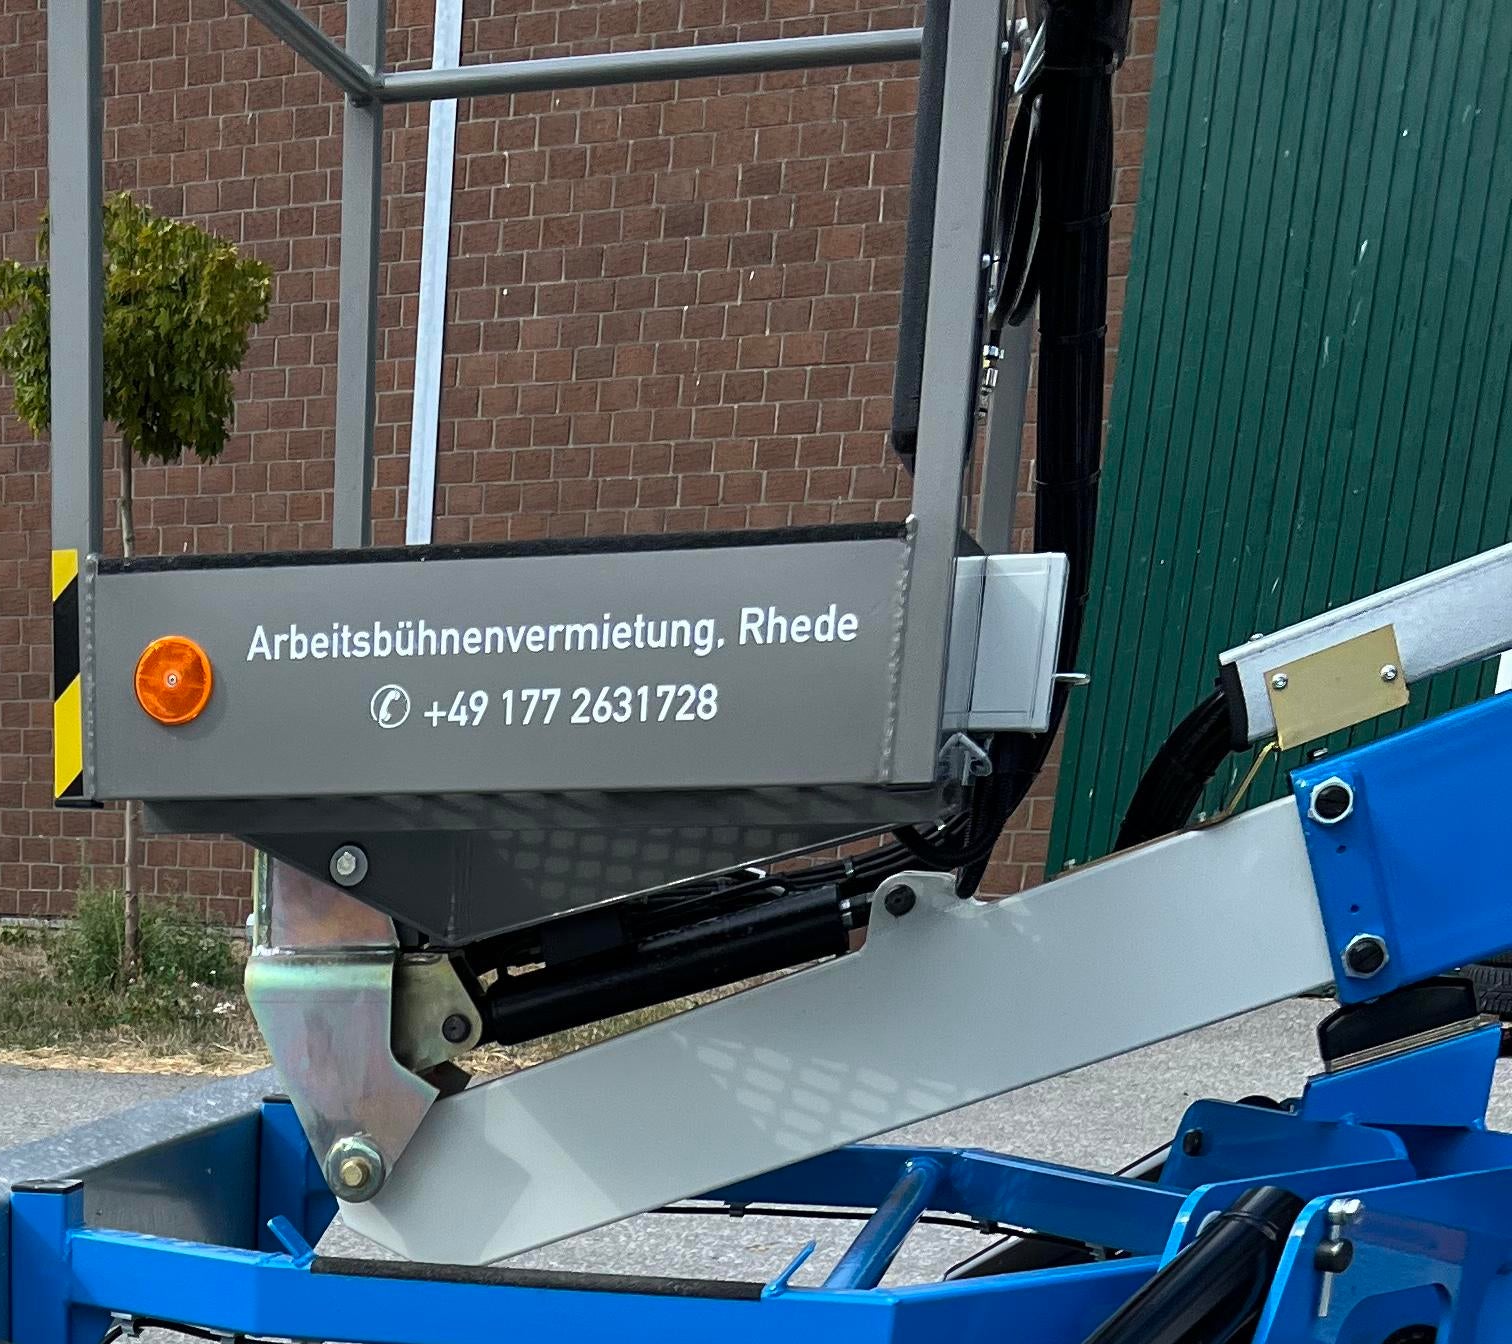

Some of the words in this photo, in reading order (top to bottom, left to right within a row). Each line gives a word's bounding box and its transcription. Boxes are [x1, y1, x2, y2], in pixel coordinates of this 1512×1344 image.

[245, 611, 726, 663] Arbeitsbühnenvermietung,
[738, 603, 860, 646] Rhede
[423, 689, 489, 728] +49
[501, 687, 562, 727] 177
[570, 682, 719, 725] 2631728
